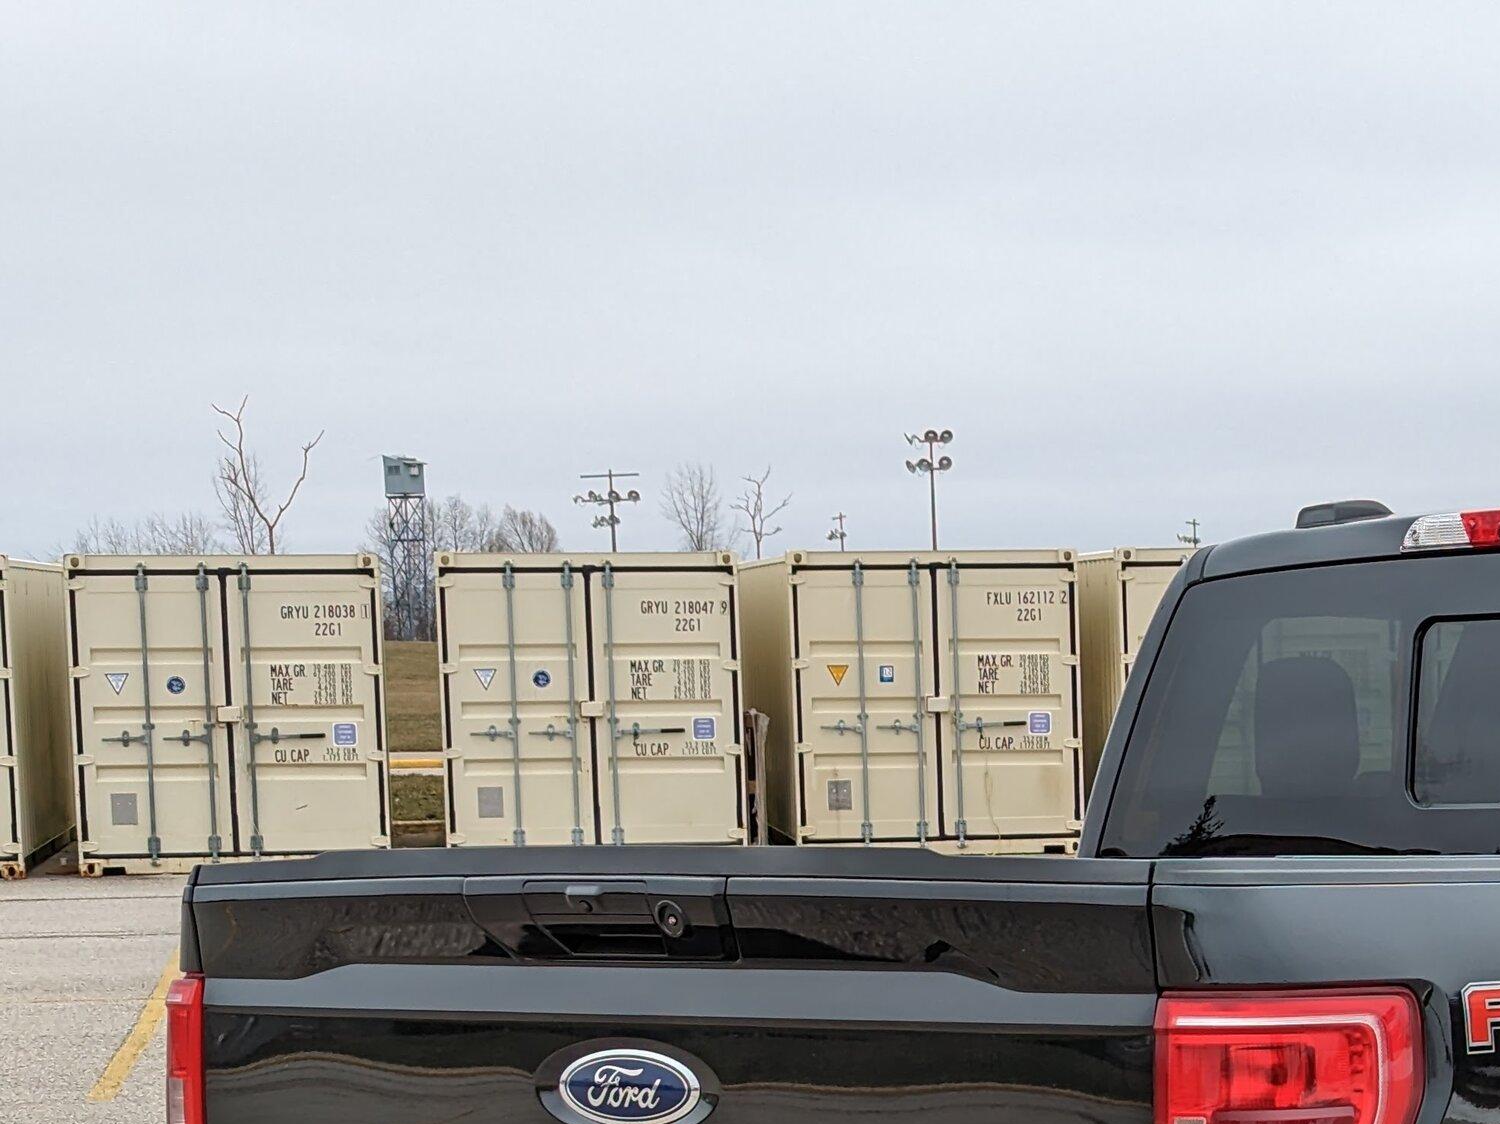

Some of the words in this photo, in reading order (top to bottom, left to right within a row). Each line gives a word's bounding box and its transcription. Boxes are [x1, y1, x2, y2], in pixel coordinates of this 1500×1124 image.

[986, 592, 1011, 605] FXLU
[1018, 591, 1054, 604] 162112
[1060, 590, 1067, 604] 2
[280, 606, 308, 619] GRYU
[314, 605, 355, 618] 218038
[640, 600, 668, 614] GRYU
[674, 600, 714, 614] 218047
[721, 600, 728, 614] 9
[1017, 608, 1042, 621] 22G1
[315, 622, 341, 636] 22G1
[675, 618, 701, 632] 22G1
[631, 673, 652, 686] TARE
[978, 668, 999, 680] TARE
[271, 678, 294, 691] TARE
[978, 681, 996, 693] NET
[271, 692, 288, 705] NET
[631, 687, 647, 699] NET
[587, 1064, 661, 1110] Ford
